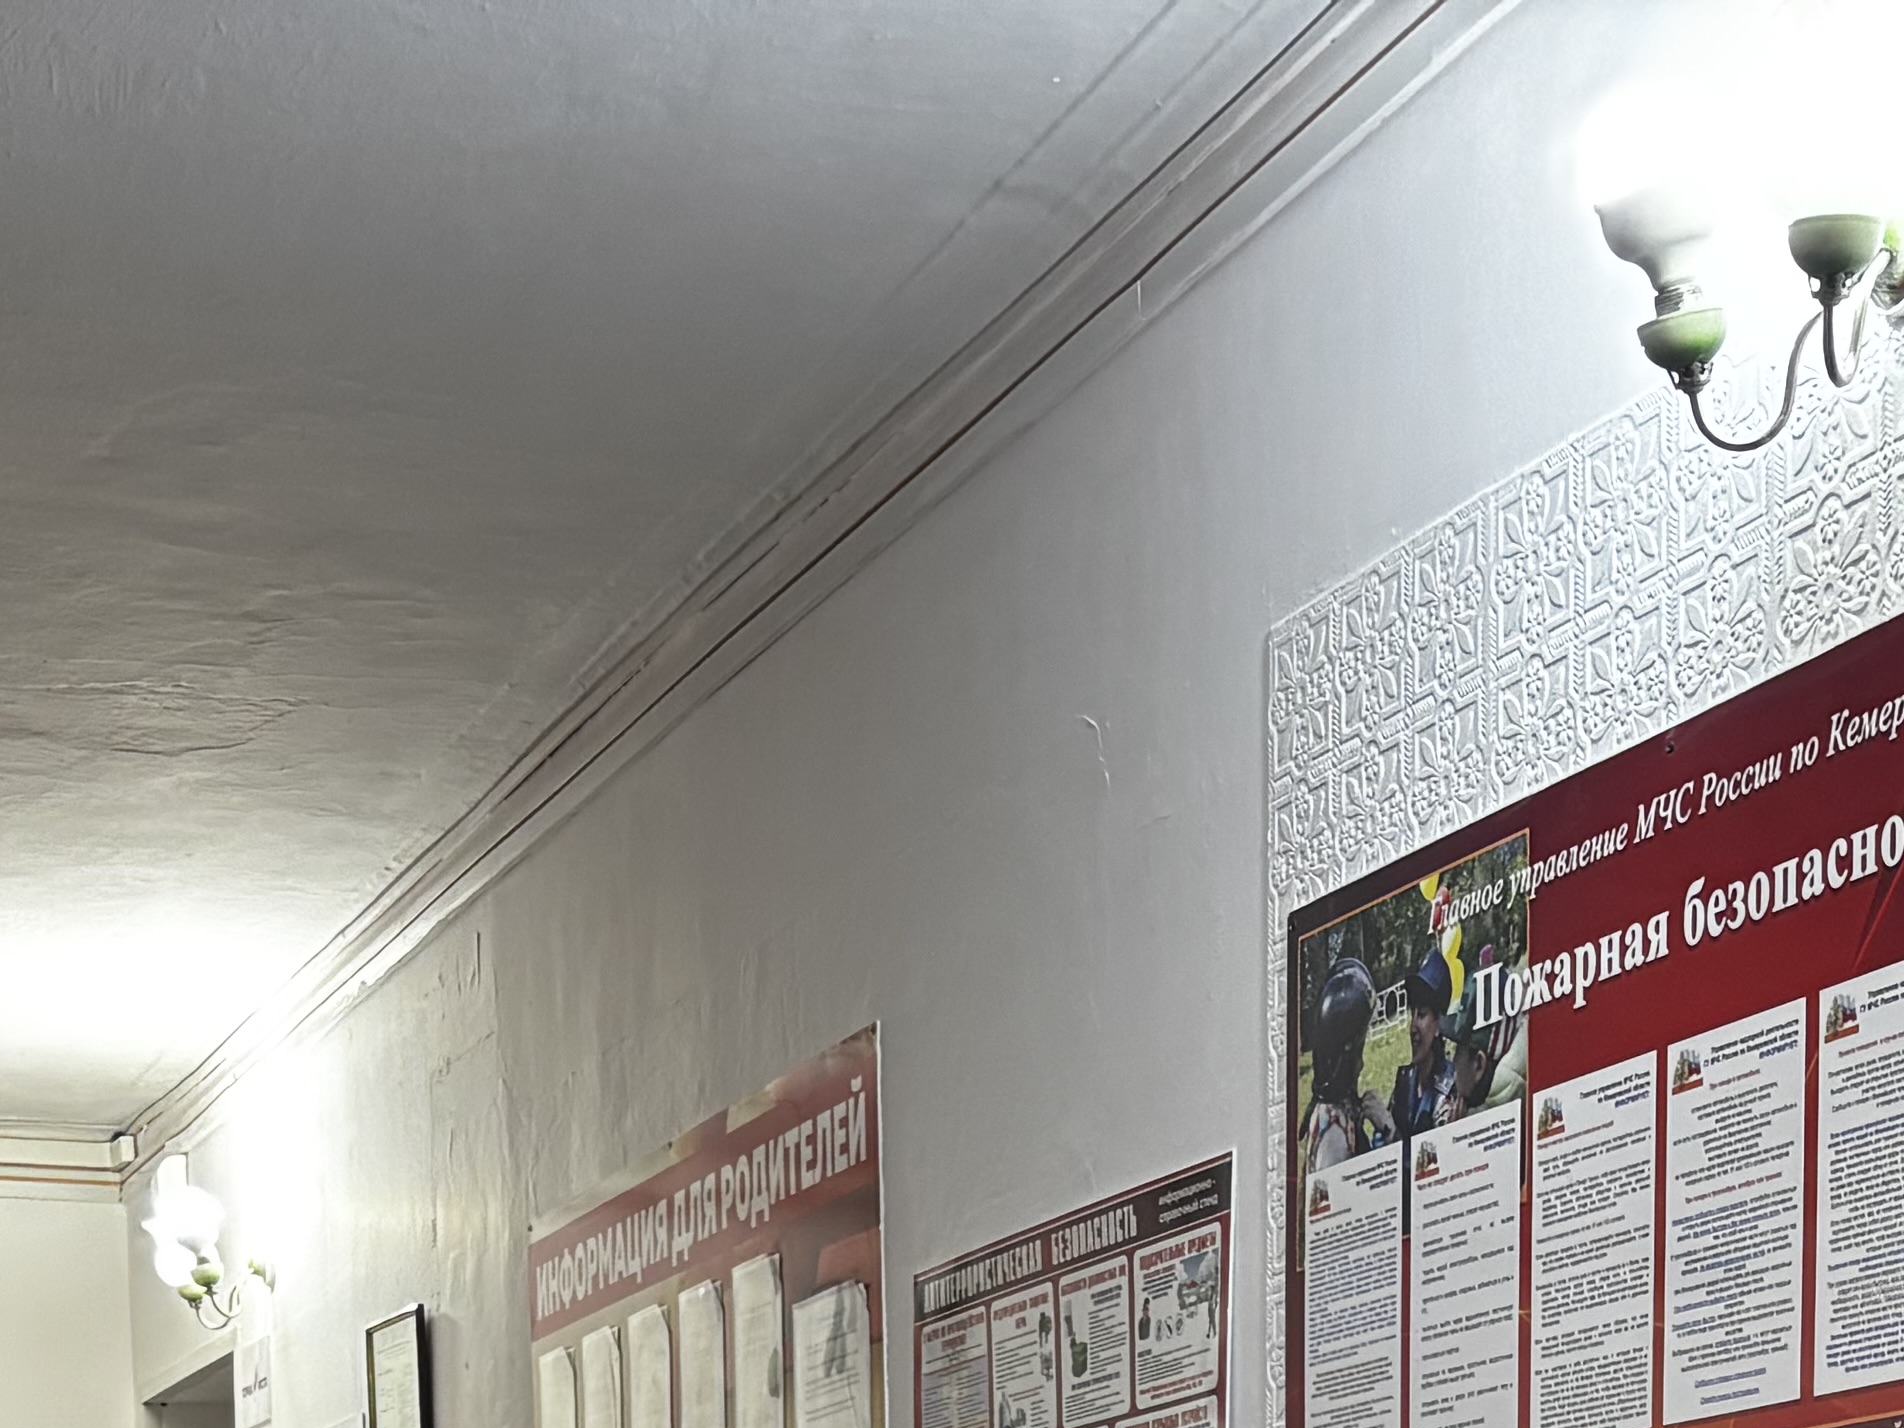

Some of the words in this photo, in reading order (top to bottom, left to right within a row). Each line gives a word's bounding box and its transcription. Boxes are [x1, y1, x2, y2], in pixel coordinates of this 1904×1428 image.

[1427, 878, 1503, 935] Главное
[1508, 822, 1629, 909] управление
[1633, 780, 1694, 845] МЧС
[1697, 752, 1782, 815] России
[1789, 735, 1819, 775] по
[1472, 910, 1670, 1031] Пожарная
[536, 1199, 668, 1320] ИНФОРМАЦИЯ
[671, 1171, 718, 1268] ДЛЯ
[721, 1075, 867, 1230] РОДИТЕЛЕЙ
[1051, 1204, 1138, 1266] БЕЗОПАСНОСТЬ
